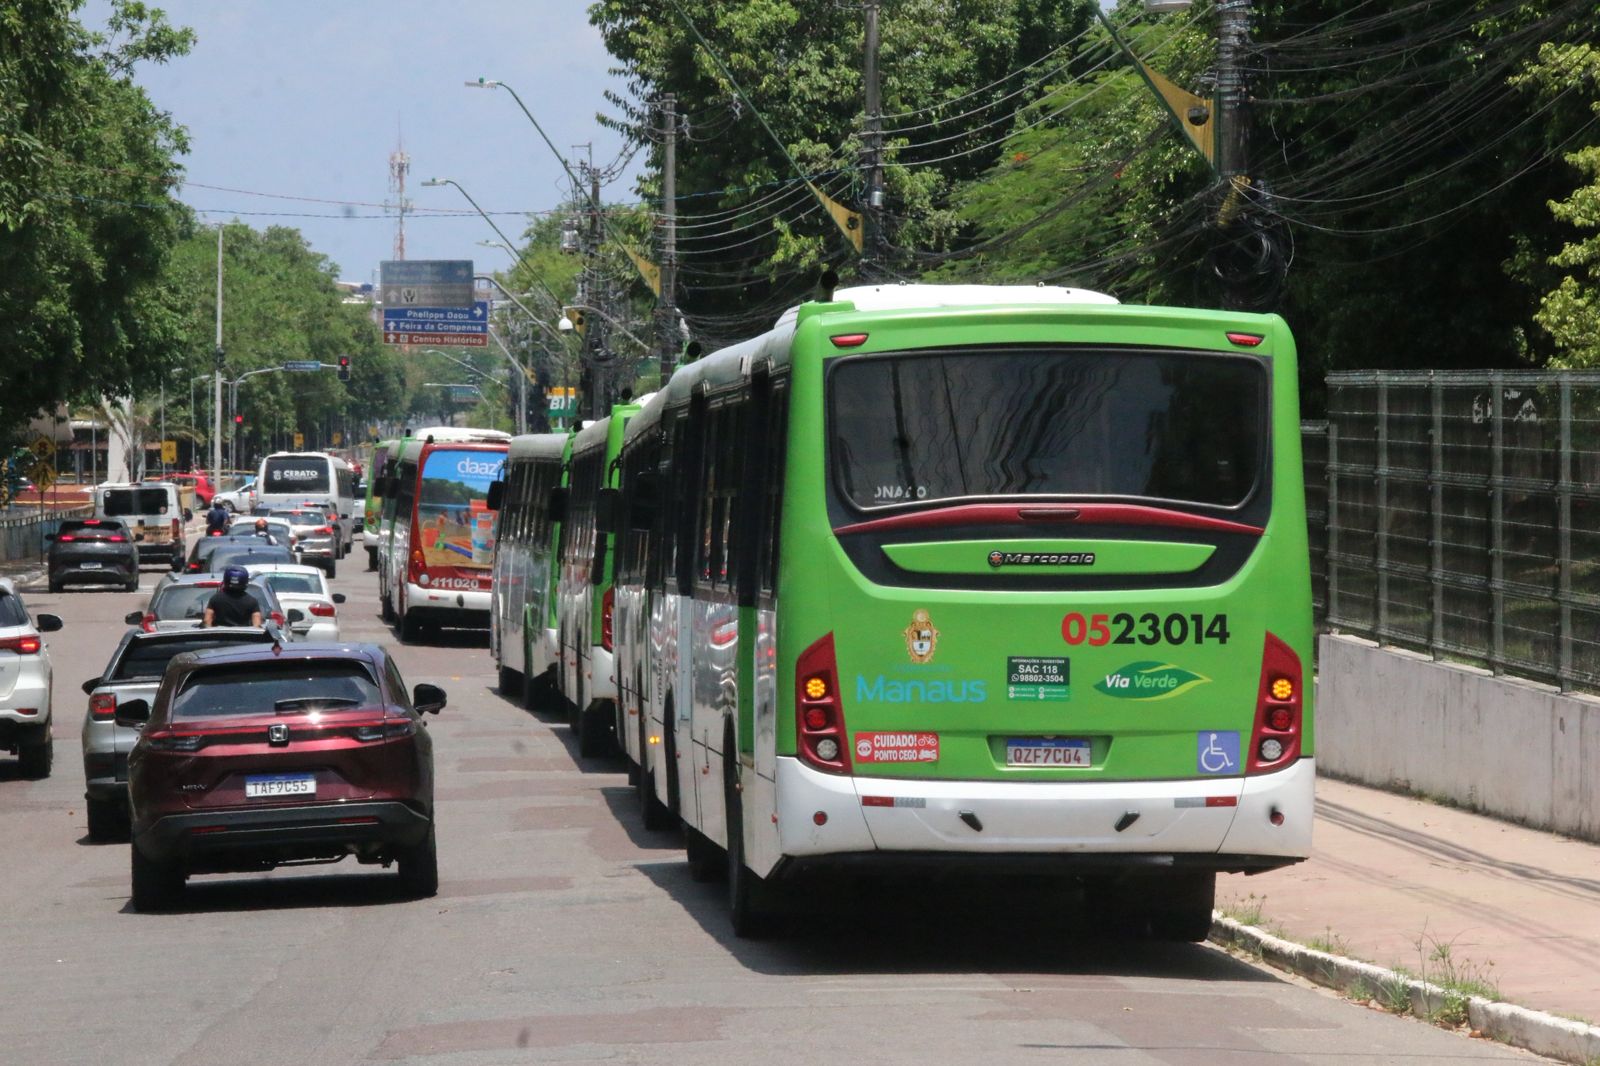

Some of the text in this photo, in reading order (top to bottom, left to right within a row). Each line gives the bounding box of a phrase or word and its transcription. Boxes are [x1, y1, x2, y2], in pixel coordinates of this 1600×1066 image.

[400, 322, 421, 330] Feira
[438, 323, 482, 332] Compensa
[412, 336, 483, 345] Centro Histórico
[283, 469, 318, 477] CERATO
[1004, 554, 1094, 565] Marcopolo
[431, 577, 479, 589] 411020
[1061, 612, 1230, 646] 0523014
[1018, 664, 1058, 674] SAC 118
[1019, 674, 1064, 682] 98802-3504
[1105, 674, 1179, 688] Via Verde
[855, 673, 988, 704] Manaus
[874, 734, 918, 747] CUIDADO!
[874, 749, 918, 761] PONTO CEGO
[1013, 748, 1082, 764] QZF7C04
[253, 780, 309, 795] TAF9C55
